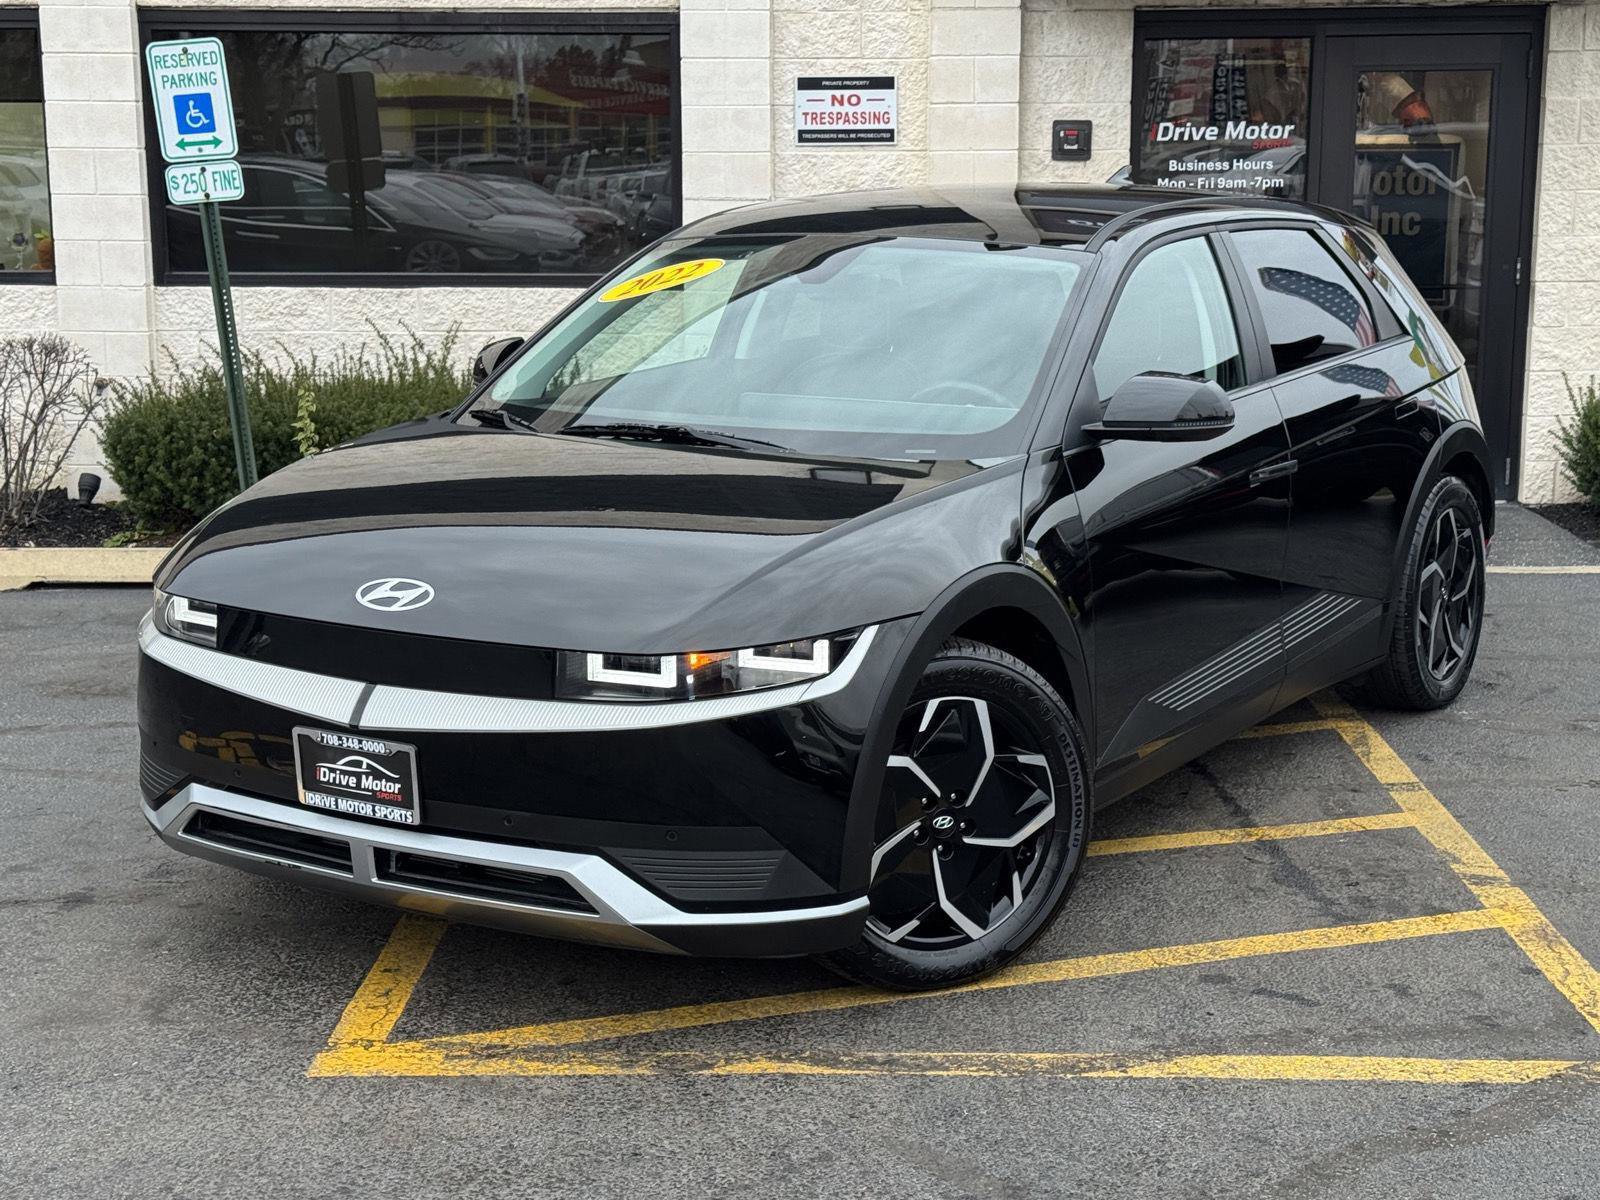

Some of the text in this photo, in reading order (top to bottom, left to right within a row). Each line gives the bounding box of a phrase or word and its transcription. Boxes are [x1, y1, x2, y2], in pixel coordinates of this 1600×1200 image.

[154, 50, 218, 70] RESERVED
[161, 71, 218, 90] PARKING
[830, 94, 862, 107] NO
[802, 111, 891, 125] TRESPASSING
[1224, 120, 1295, 141] Motor
[1168, 158, 1274, 172] Business Hours
[170, 169, 240, 194] $250 FINE
[1157, 177, 1186, 188] Mon
[1217, 177, 1247, 189] 9am
[1370, 205, 1421, 236] Inc
[616, 262, 705, 297] 2022
[321, 733, 385, 754] 708-348-0000
[315, 766, 402, 794] iDrive Motor
[1059, 733, 1083, 832] DESTINATION
[375, 791, 402, 802] SPORTS
[337, 798, 373, 816] MOTOR
[374, 804, 413, 823] SPORTS
